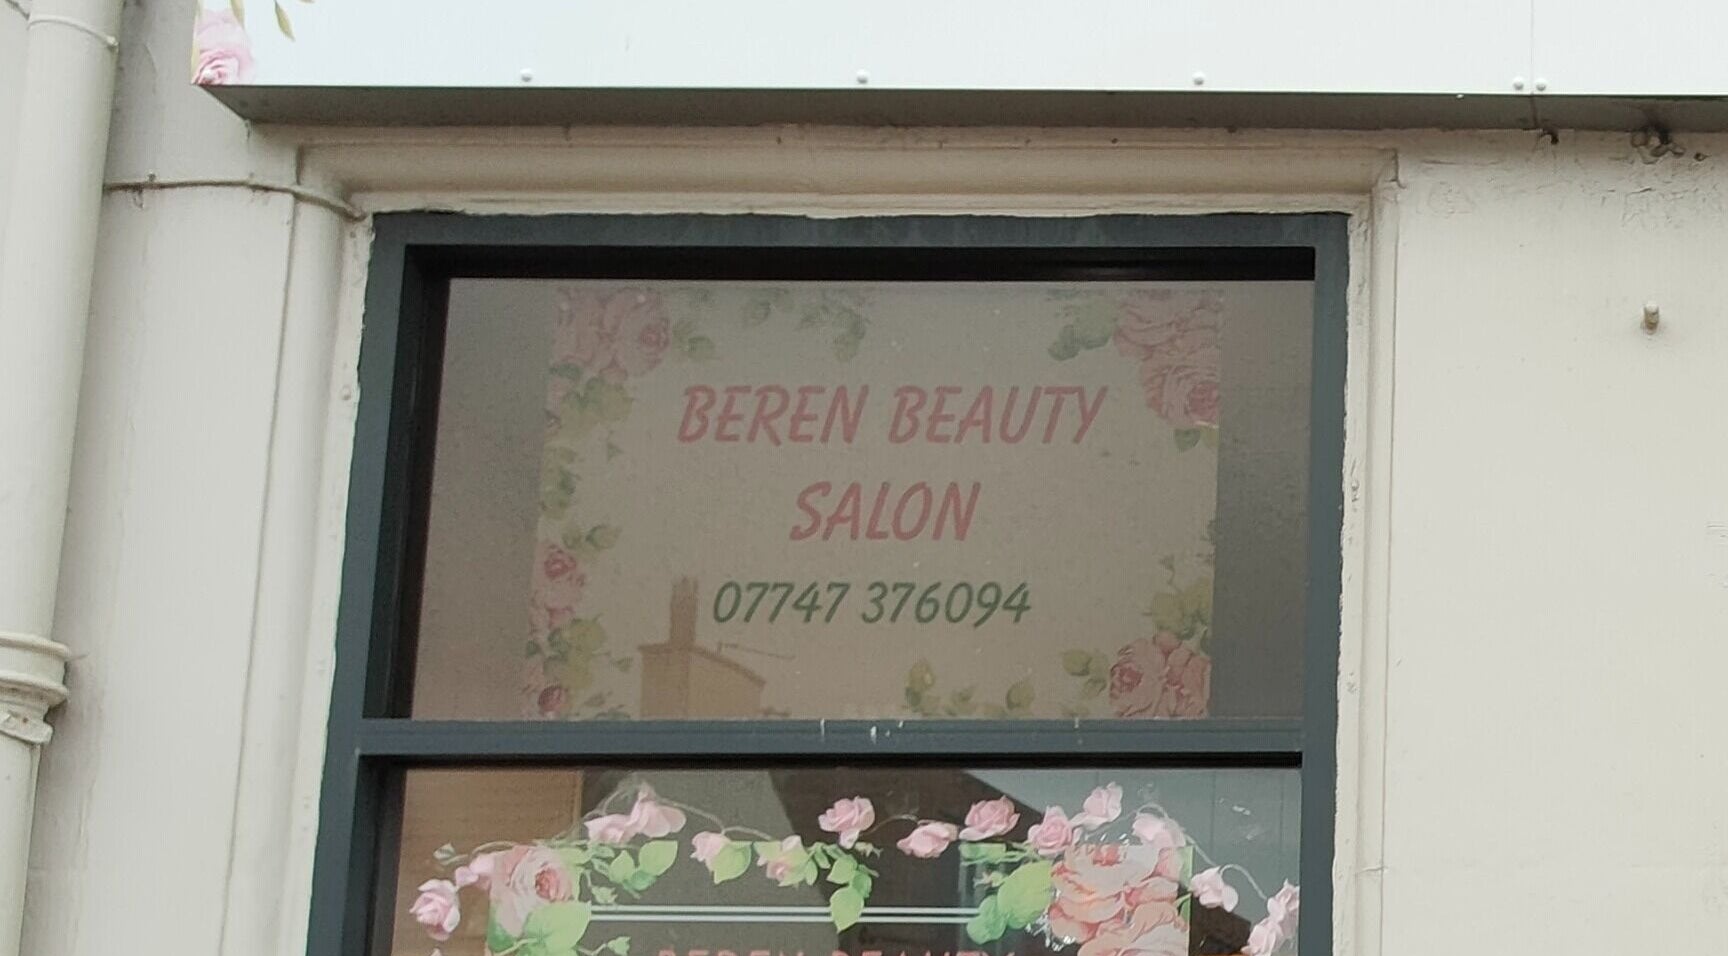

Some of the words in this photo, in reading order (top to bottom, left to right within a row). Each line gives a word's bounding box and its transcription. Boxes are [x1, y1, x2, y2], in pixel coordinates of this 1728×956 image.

[677, 384, 869, 446] BEREN
[888, 385, 1108, 444] BEAUTY
[789, 481, 981, 541] SALON
[713, 582, 850, 624] 07747
[861, 582, 1031, 628] 376094
